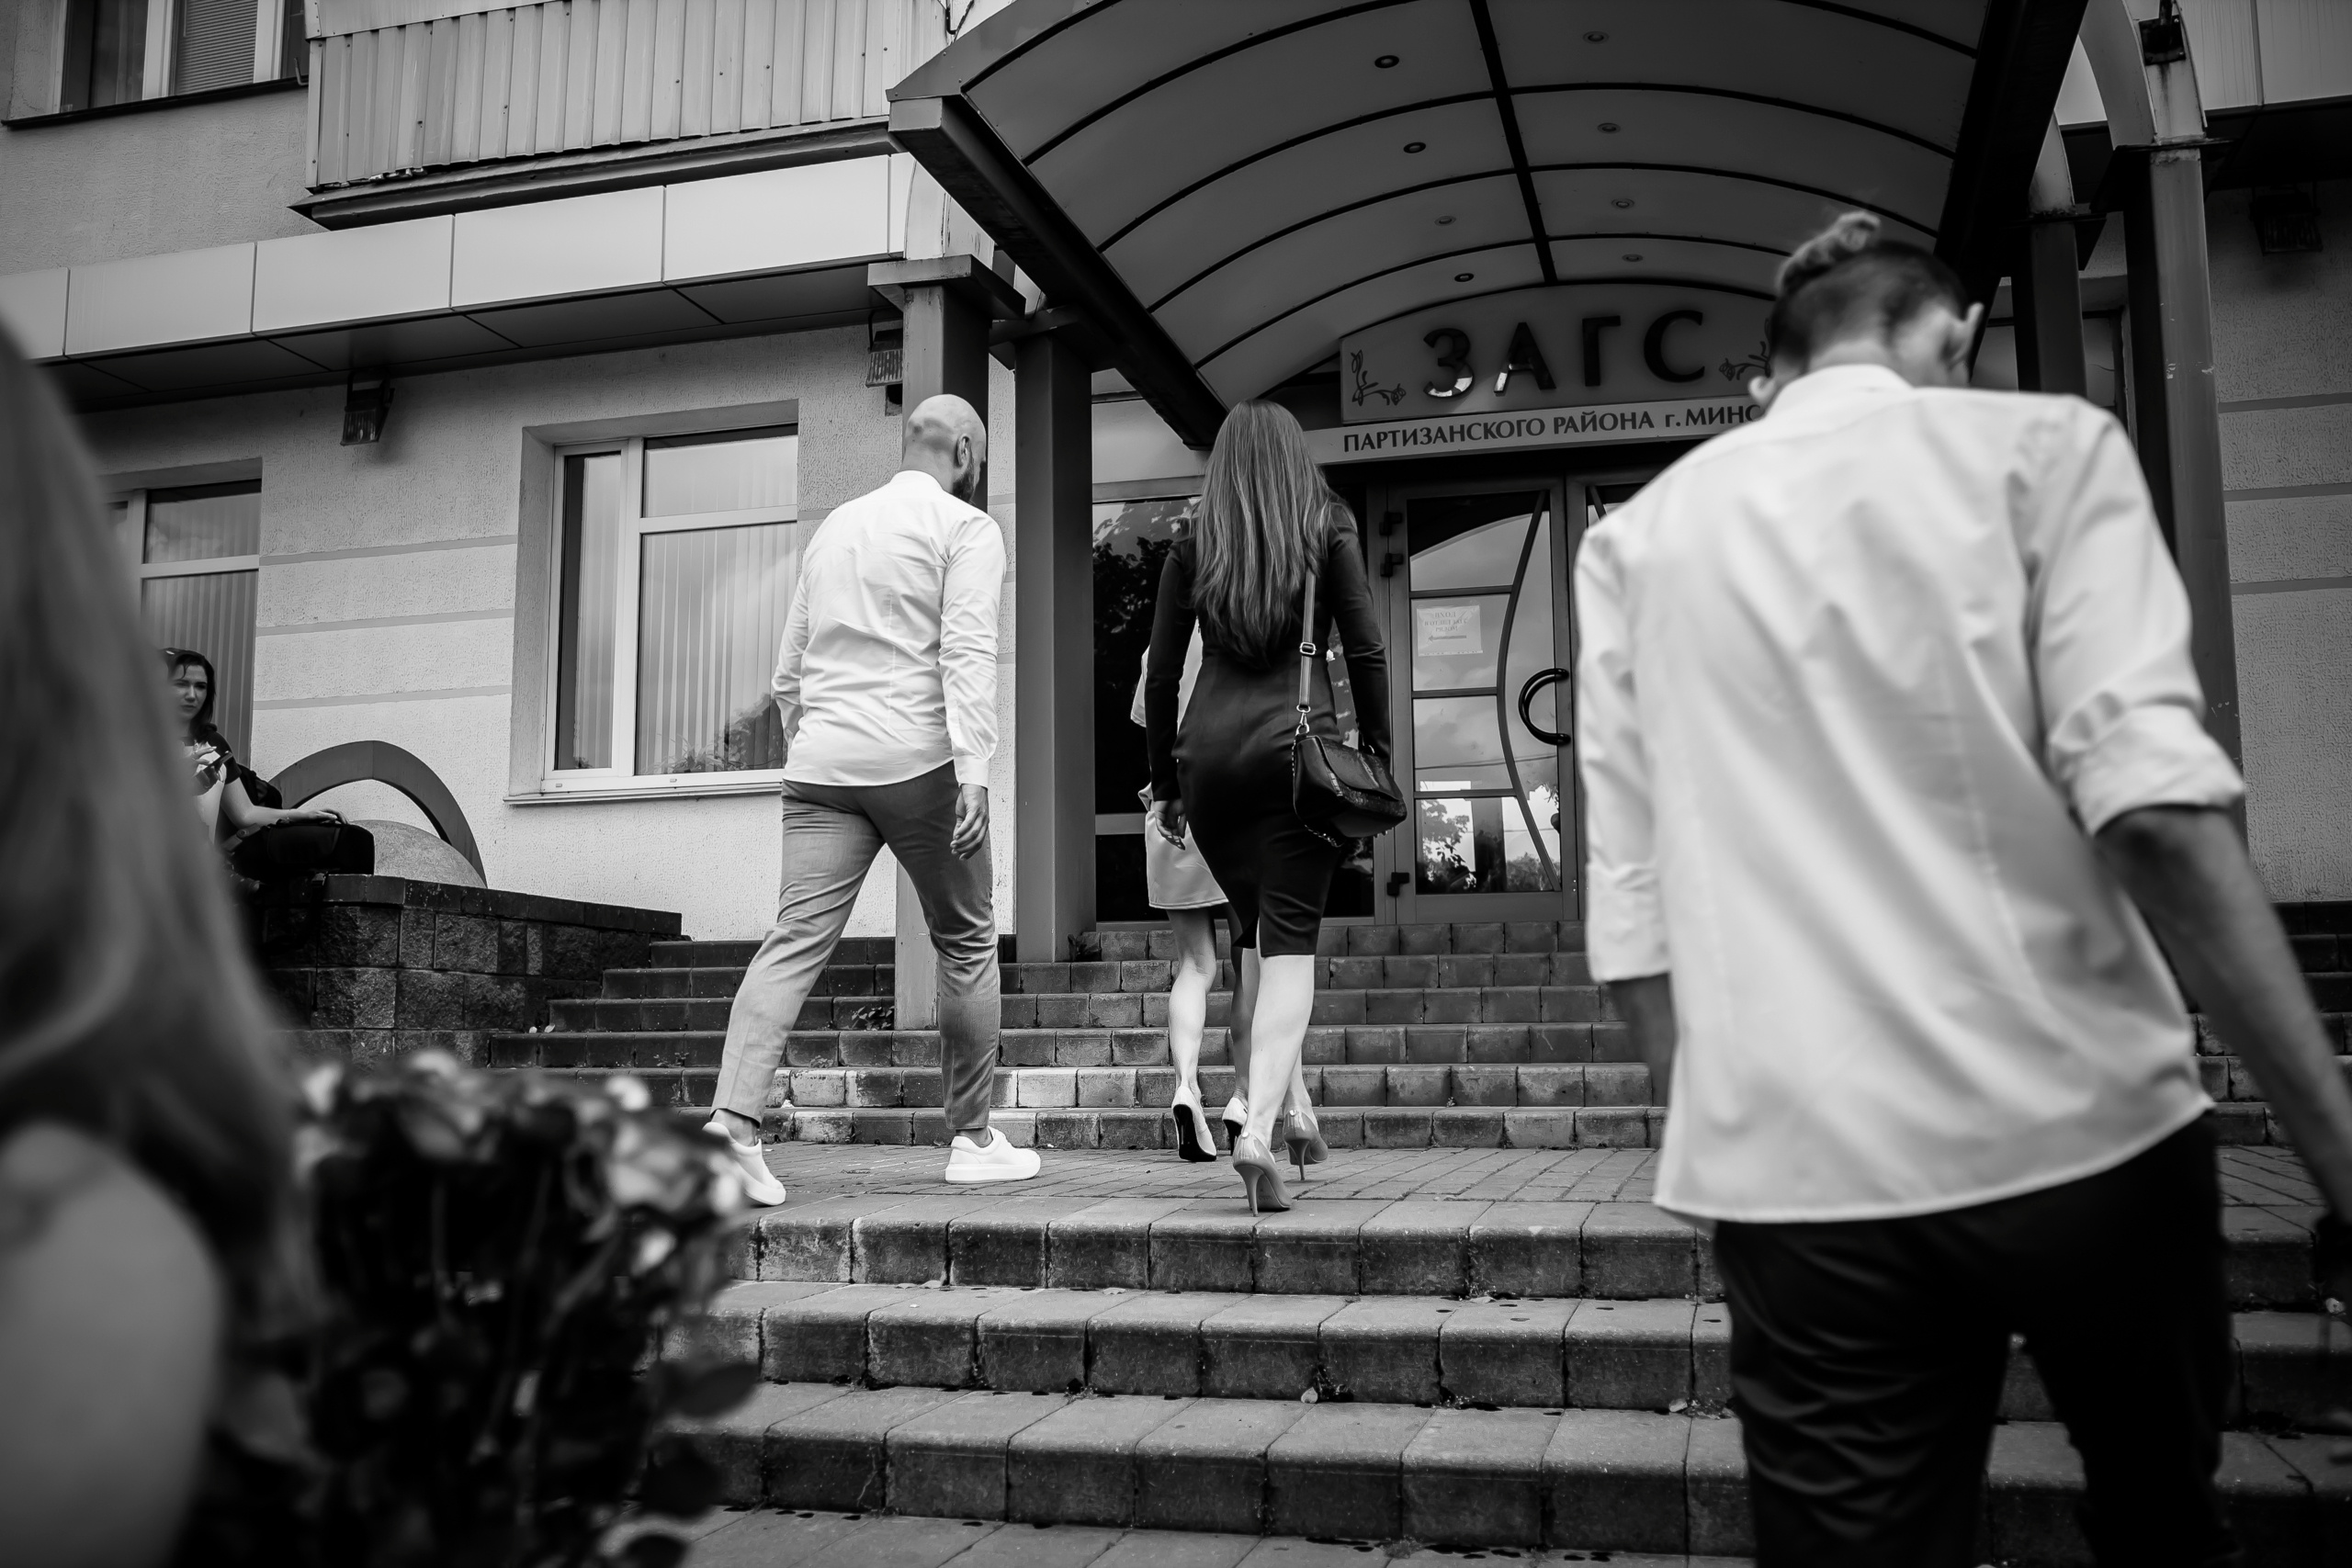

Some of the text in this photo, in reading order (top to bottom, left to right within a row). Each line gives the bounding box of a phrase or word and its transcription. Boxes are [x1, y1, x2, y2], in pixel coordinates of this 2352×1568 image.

[1423, 310, 1705, 398] ЗАГС
[1343, 418, 1546, 453] ПАРТИЗАНСКОГО
[1553, 410, 1655, 435] РАЙОНА
